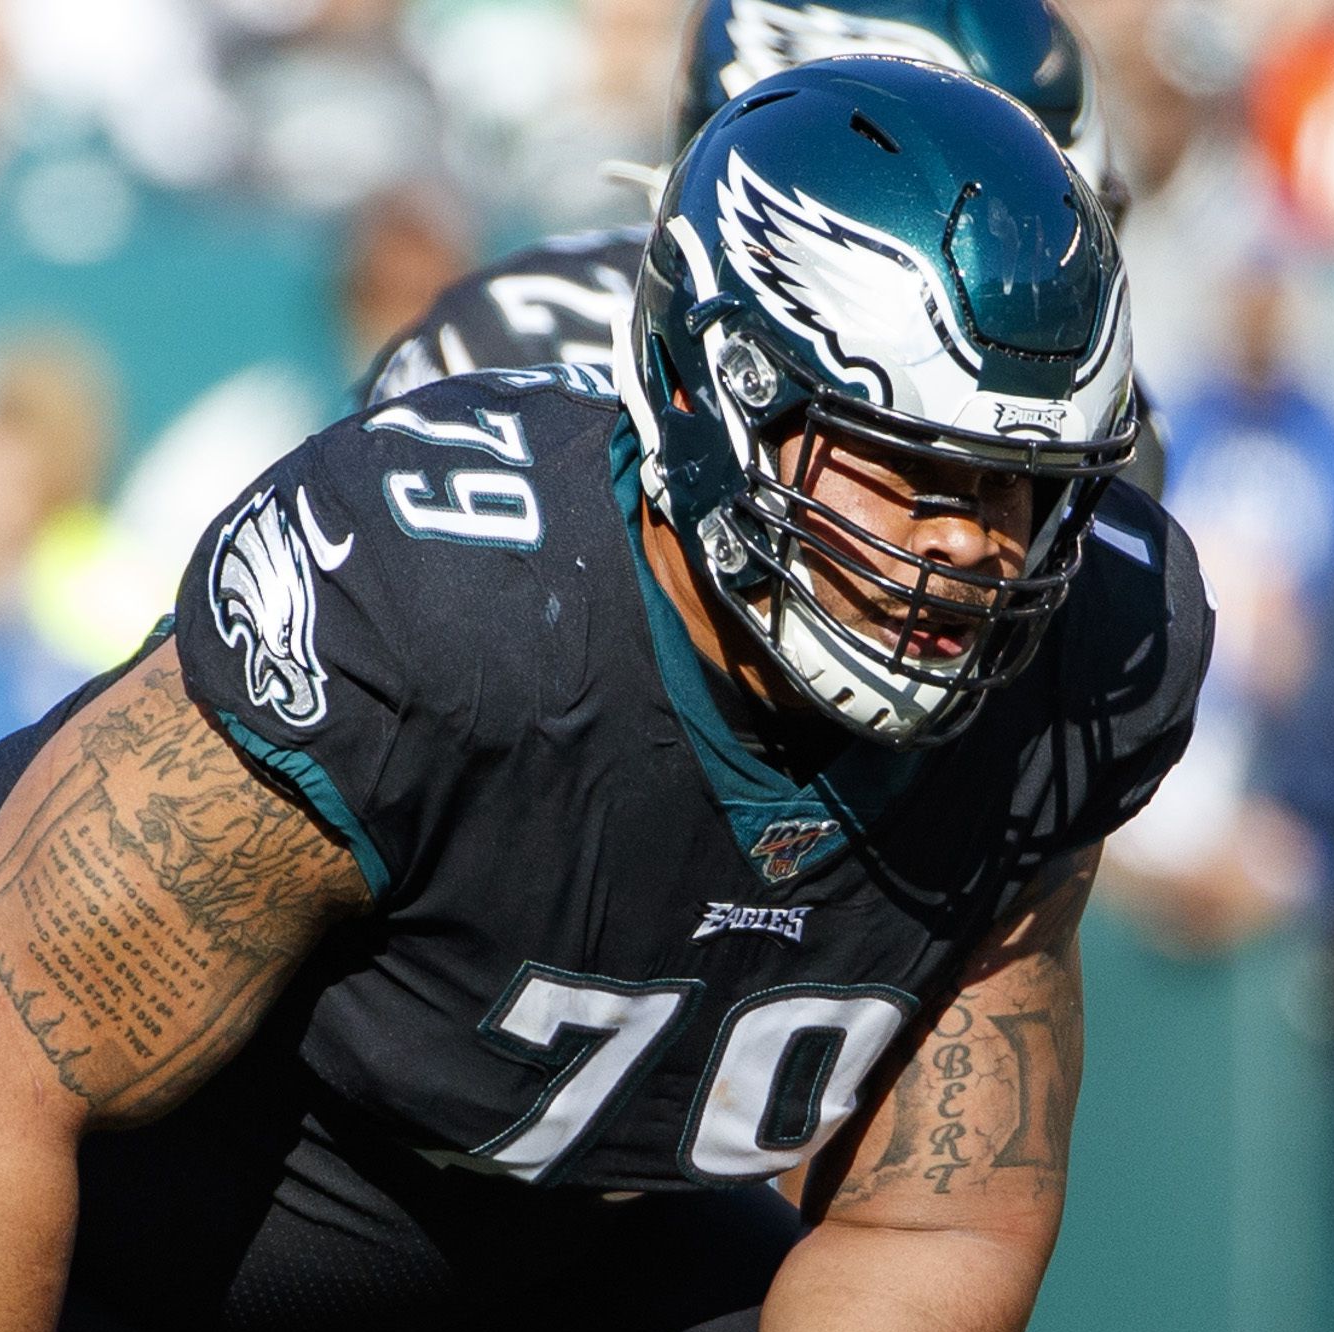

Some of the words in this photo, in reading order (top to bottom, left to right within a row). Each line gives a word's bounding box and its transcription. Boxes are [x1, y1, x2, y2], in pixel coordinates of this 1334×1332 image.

[994, 401, 1066, 440] EAGLES
[363, 405, 548, 553] 79
[691, 901, 815, 941] EAGLES
